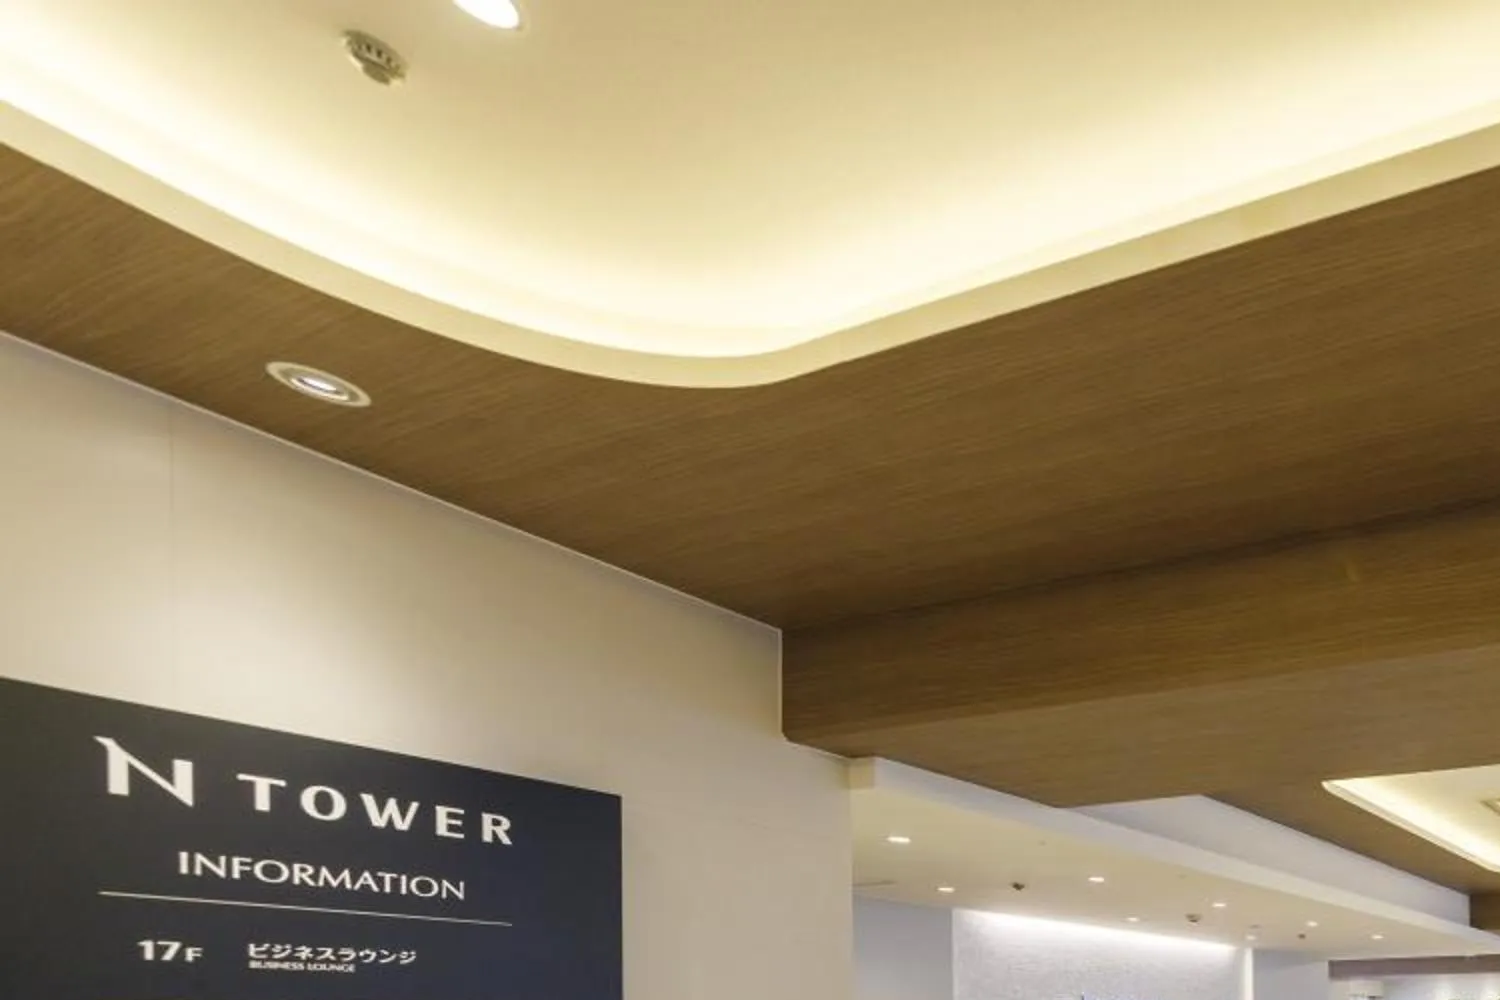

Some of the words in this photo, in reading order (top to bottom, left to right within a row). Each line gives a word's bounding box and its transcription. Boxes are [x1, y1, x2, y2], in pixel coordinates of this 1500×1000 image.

[94, 736, 193, 807] N
[237, 773, 513, 845] TOWER
[179, 851, 465, 900] INFORMATION
[137, 940, 202, 965] 17F
[248, 943, 417, 965] ビジネスラウンジ
